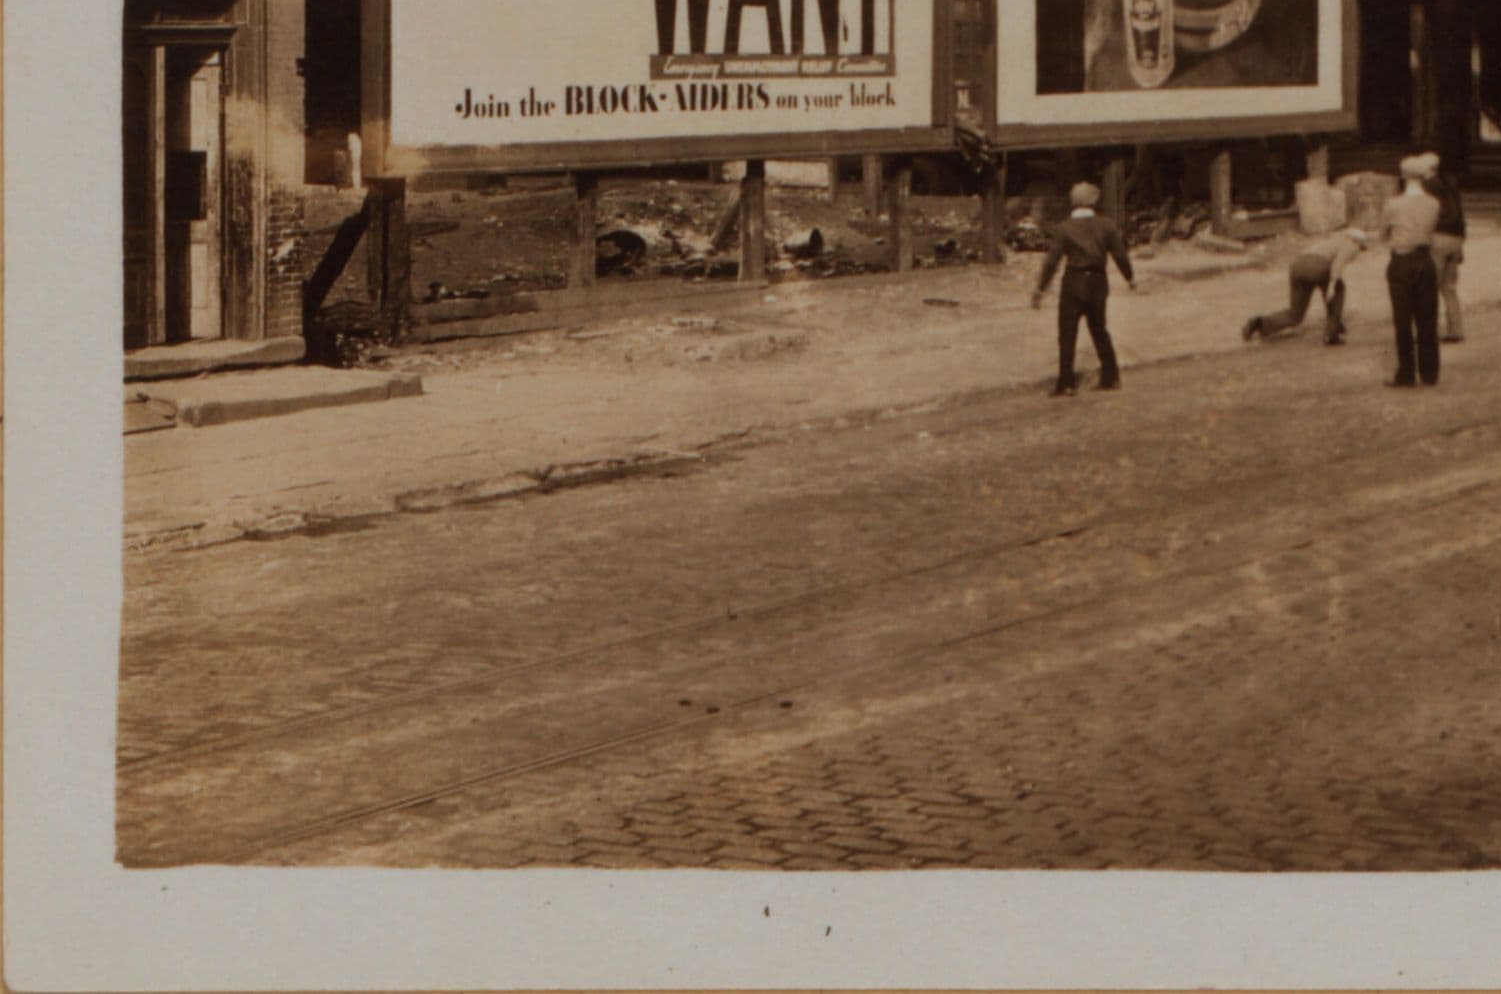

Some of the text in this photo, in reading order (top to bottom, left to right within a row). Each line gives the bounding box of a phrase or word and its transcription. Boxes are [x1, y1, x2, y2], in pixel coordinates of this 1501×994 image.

[455, 87, 510, 118] Join
[519, 86, 556, 117] the
[776, 93, 799, 111] on
[803, 93, 843, 112] your
[850, 82, 896, 108] block
